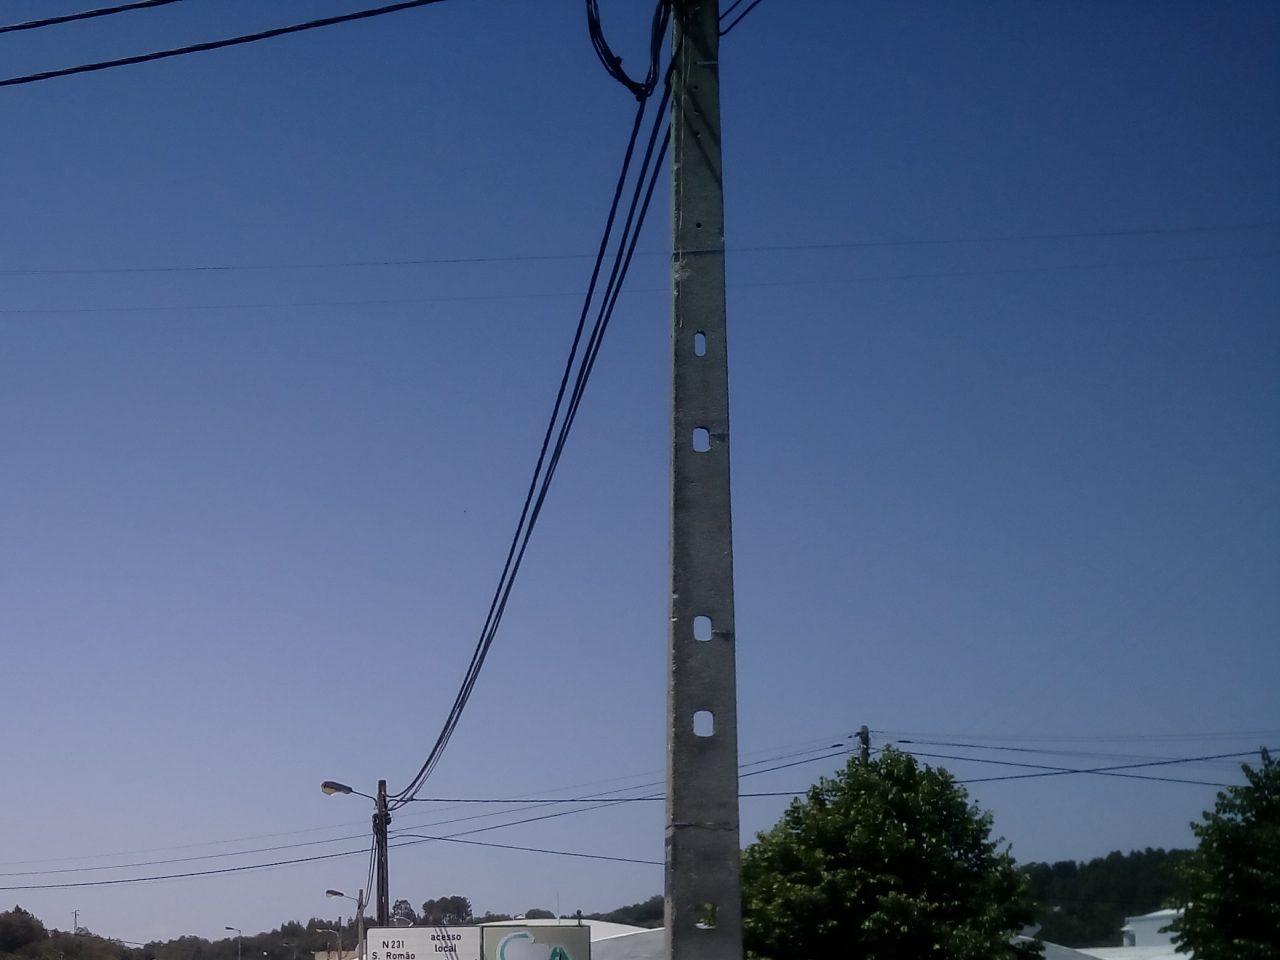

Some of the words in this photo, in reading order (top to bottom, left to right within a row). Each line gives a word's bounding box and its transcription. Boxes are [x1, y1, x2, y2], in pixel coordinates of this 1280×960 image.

[434, 944, 457, 953] local
[371, 951, 380, 960] S.
[386, 951, 416, 960] Romão
